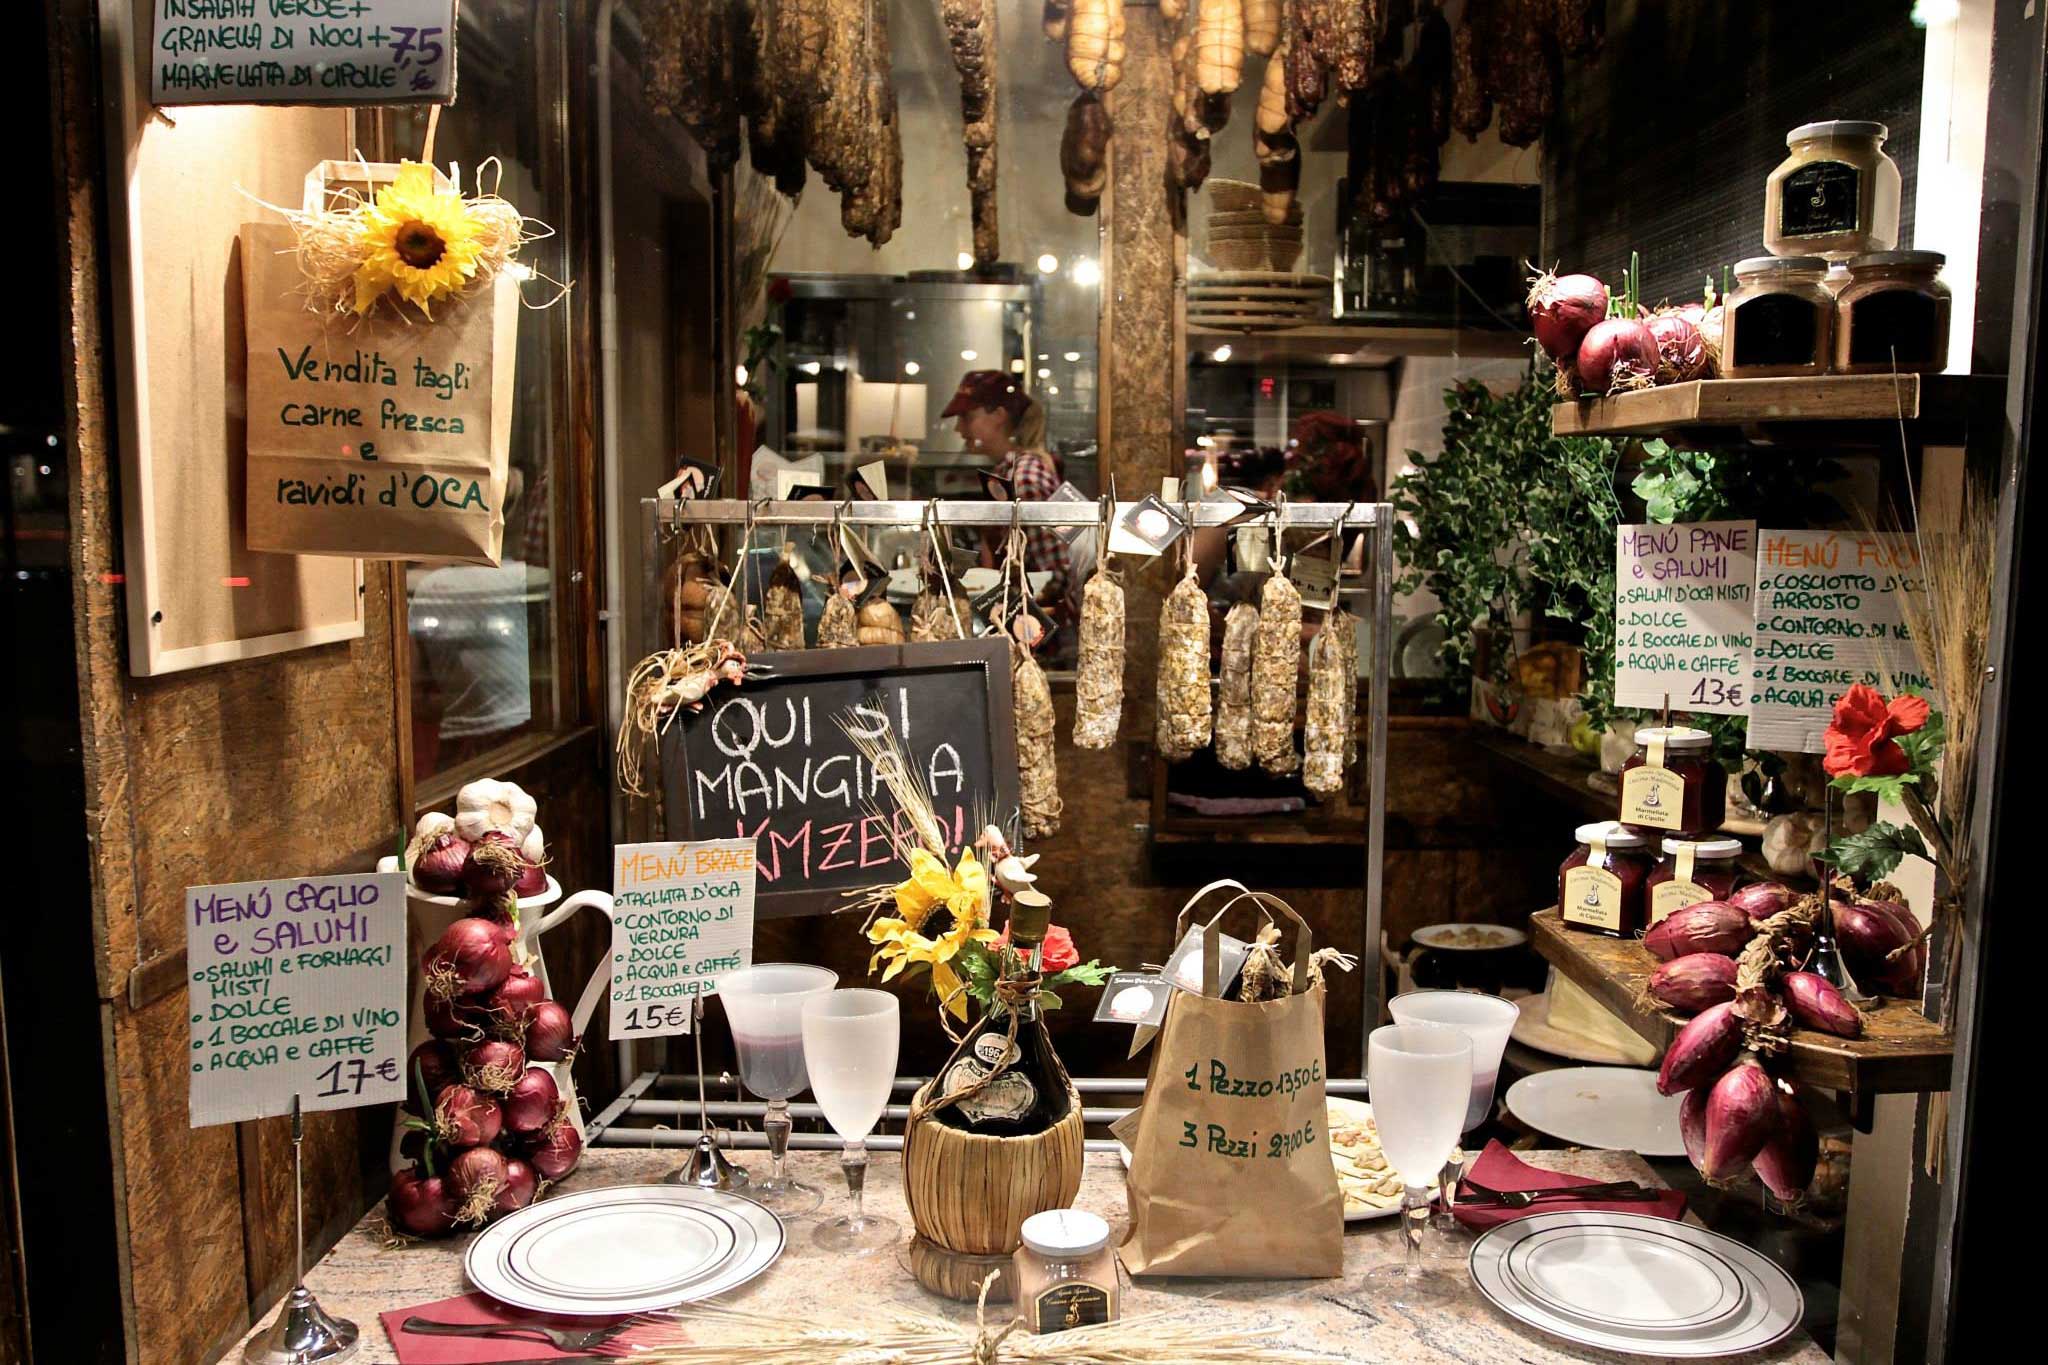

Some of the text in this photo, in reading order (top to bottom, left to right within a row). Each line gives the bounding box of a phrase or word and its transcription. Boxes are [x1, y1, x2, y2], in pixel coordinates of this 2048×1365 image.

[161, 24, 262, 57] GRANELLA
[271, 27, 293, 49] DI
[161, 61, 398, 91] MARMELLATA DI CIPOLLE
[277, 345, 470, 400] Vendita tagli
[281, 398, 465, 434] carne fresca
[359, 441, 379, 461] e
[378, 472, 490, 512] d'OCA
[1689, 527, 1748, 554] PANE
[1632, 556, 1728, 580] e SALUMI
[1627, 583, 1750, 604] SALUMI D'OCA MISTI
[1773, 573, 1876, 591] COSCIOTTO
[1771, 591, 1861, 611] ARROSTO
[1628, 611, 1688, 628] DOLCE
[1770, 615, 1865, 636] CONTORNO
[1866, 622, 1887, 640] DI
[1627, 631, 1753, 649] 1 BOCCALE DI VINO
[1767, 639, 1836, 662] DOLCE
[1628, 653, 1676, 675] ACQUA
[1678, 657, 1688, 671] e
[1766, 665, 1778, 682] 1
[1782, 666, 1854, 684] BOCCALE
[1860, 671, 1881, 686] DI
[1688, 677, 1744, 708] 13€
[1764, 686, 1825, 708] ACQUA
[711, 687, 910, 761] QUI SI
[695, 742, 964, 820] MANGIA A
[695, 848, 754, 876] BRACE
[285, 882, 380, 914] CAGLIO
[622, 881, 742, 908] TAGLIATA D'OCA
[624, 905, 734, 930] CONTORNO DI
[213, 911, 369, 955] e SALUMI
[628, 925, 700, 946] VERDURA
[206, 944, 393, 984] SALUMI e FORMAGGI
[628, 942, 687, 963] DOLCE
[626, 963, 678, 983] ACQUA
[682, 963, 691, 976] e
[210, 978, 271, 1000] MISTI
[624, 979, 716, 1002] 1 BOCCALE DI
[208, 996, 292, 1023] DOLCE
[623, 1004, 687, 1031] 15€
[208, 1006, 401, 1048] 1 BOCCALE DI VINO
[209, 1044, 279, 1072] ACQUA
[286, 1045, 301, 1061] e
[984, 1045, 1001, 1059] 196
[315, 1057, 401, 1098] 17€
[1184, 1061, 1202, 1092] 1
[1210, 1058, 1275, 1098] Pezzo
[1178, 1120, 1198, 1149] 3
[1206, 1122, 1258, 1159] Pezzi
